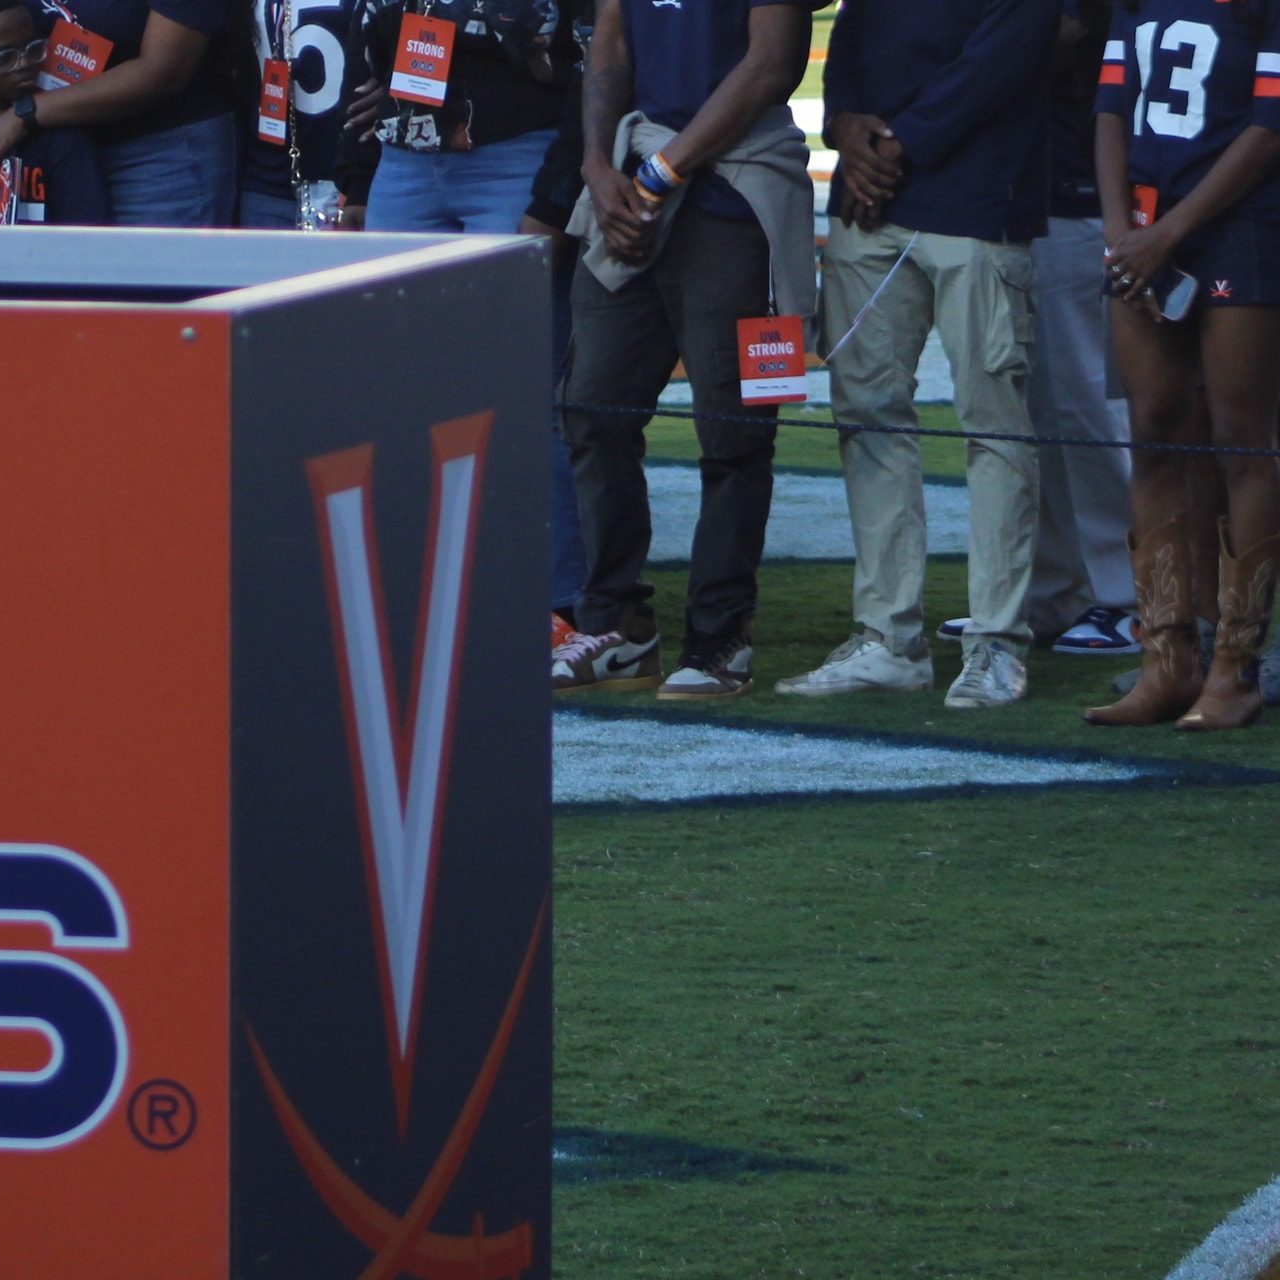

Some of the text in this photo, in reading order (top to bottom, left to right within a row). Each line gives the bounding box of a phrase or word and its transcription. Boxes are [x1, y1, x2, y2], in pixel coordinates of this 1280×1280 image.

[53, 43, 98, 72] STRONG
[405, 39, 445, 59] STRONG
[1132, 18, 1221, 140] 13
[747, 341, 795, 358] STRONG
